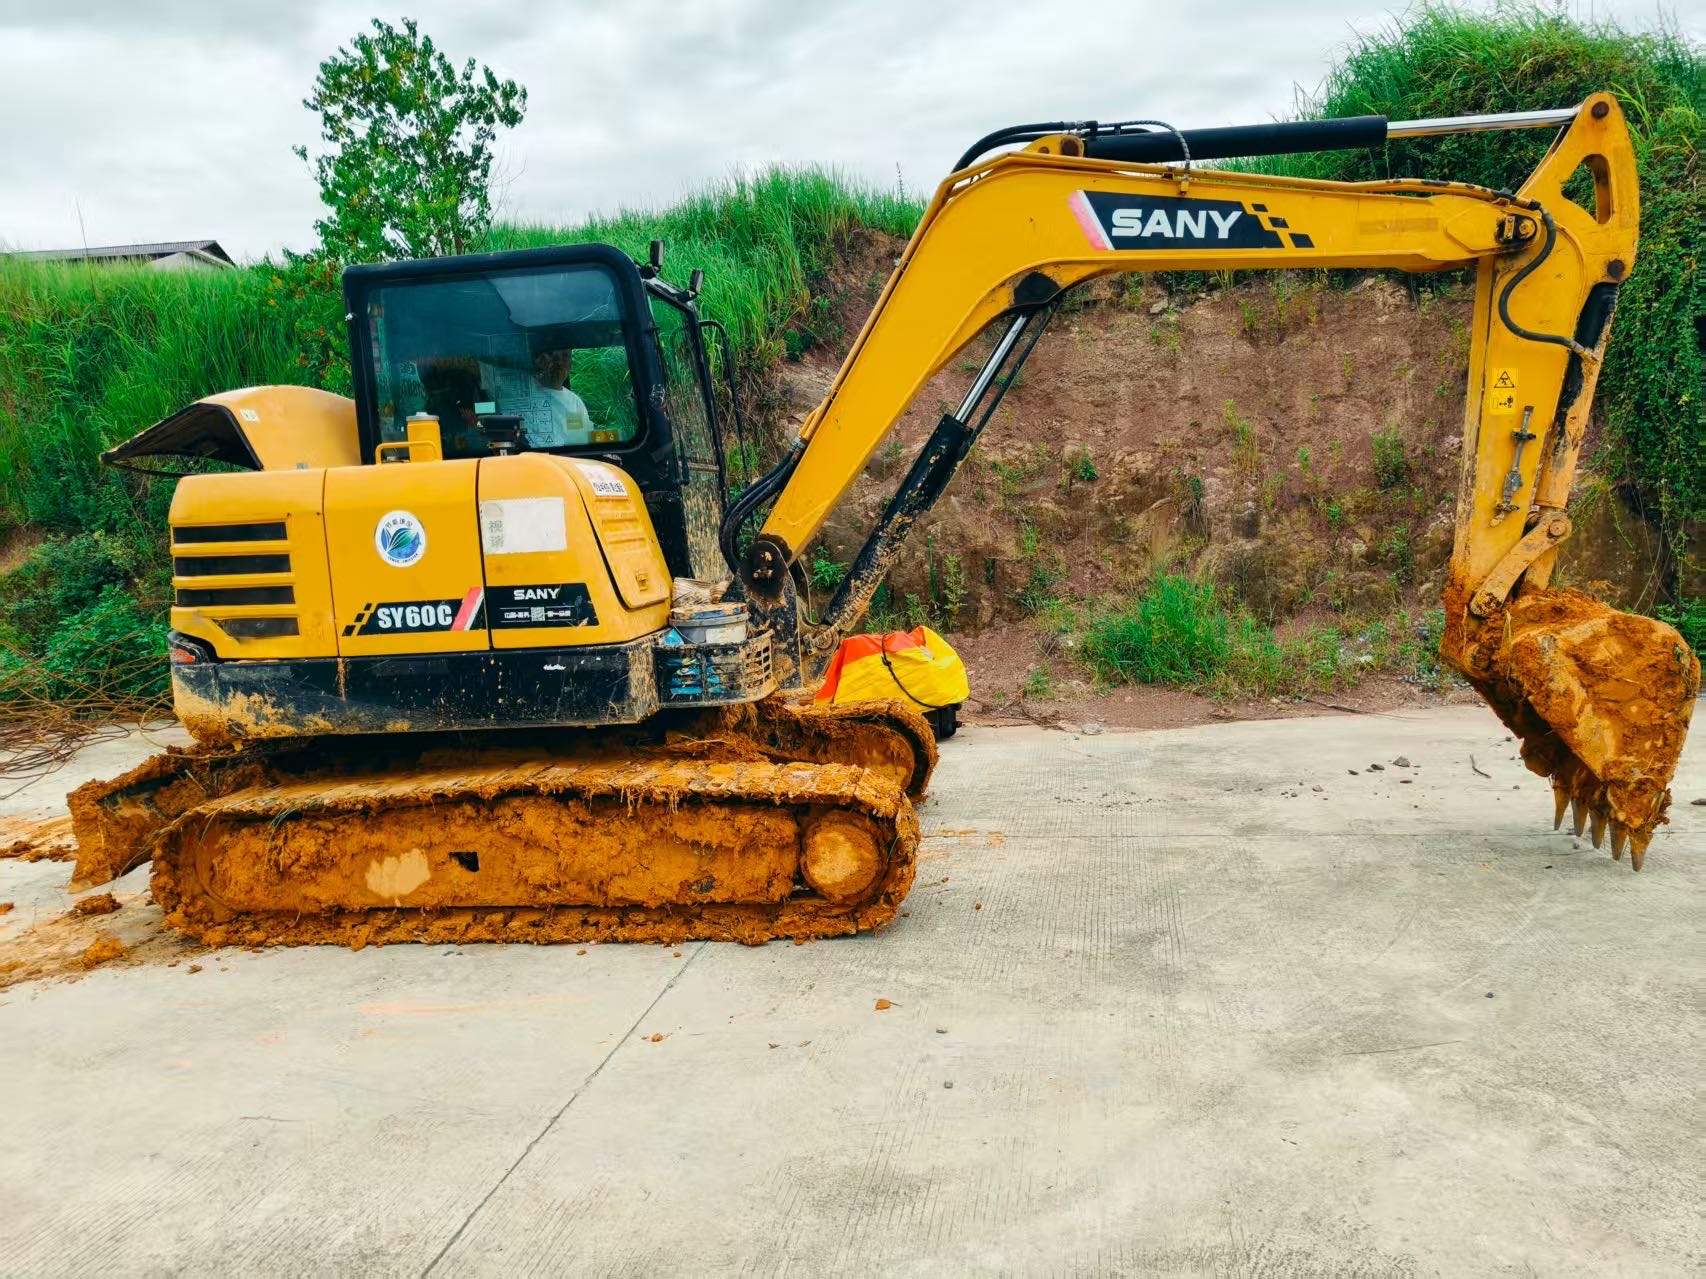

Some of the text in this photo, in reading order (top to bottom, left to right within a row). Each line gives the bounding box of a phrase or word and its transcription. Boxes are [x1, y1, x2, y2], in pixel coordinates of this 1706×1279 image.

[1112, 208, 1243, 239] SANY
[513, 587, 560, 601] SANY
[377, 604, 453, 629] SY60C
